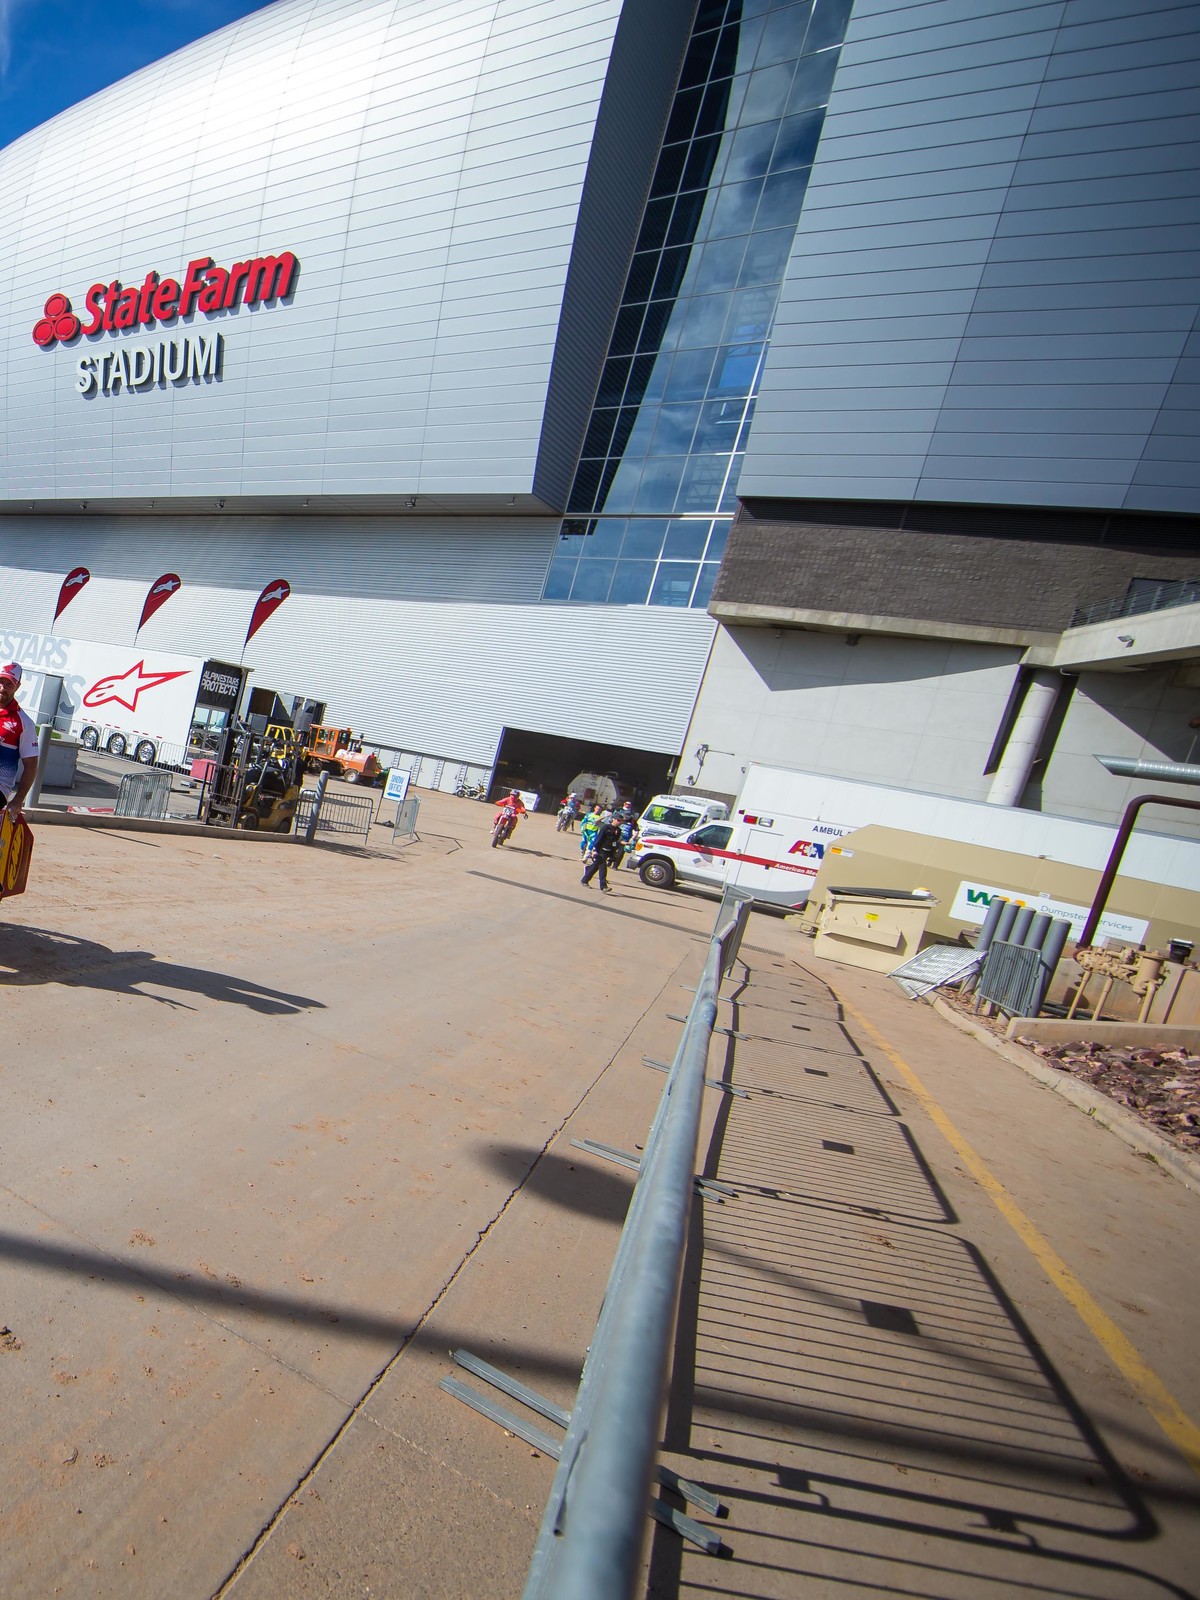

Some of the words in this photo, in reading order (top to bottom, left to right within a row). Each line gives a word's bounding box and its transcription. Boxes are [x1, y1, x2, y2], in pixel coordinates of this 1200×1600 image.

[75, 333, 223, 393] STADIUM
[202, 670, 240, 687] ALPINESTARS
[201, 678, 238, 697] PROTECTS
[391, 774, 406, 785] SHOW
[388, 783, 403, 793] OFFICE
[812, 825, 855, 838] AMBUL
[774, 862, 805, 874] American
[1040, 903, 1089, 922] Dumpster
[1097, 916, 1133, 932] ervices
